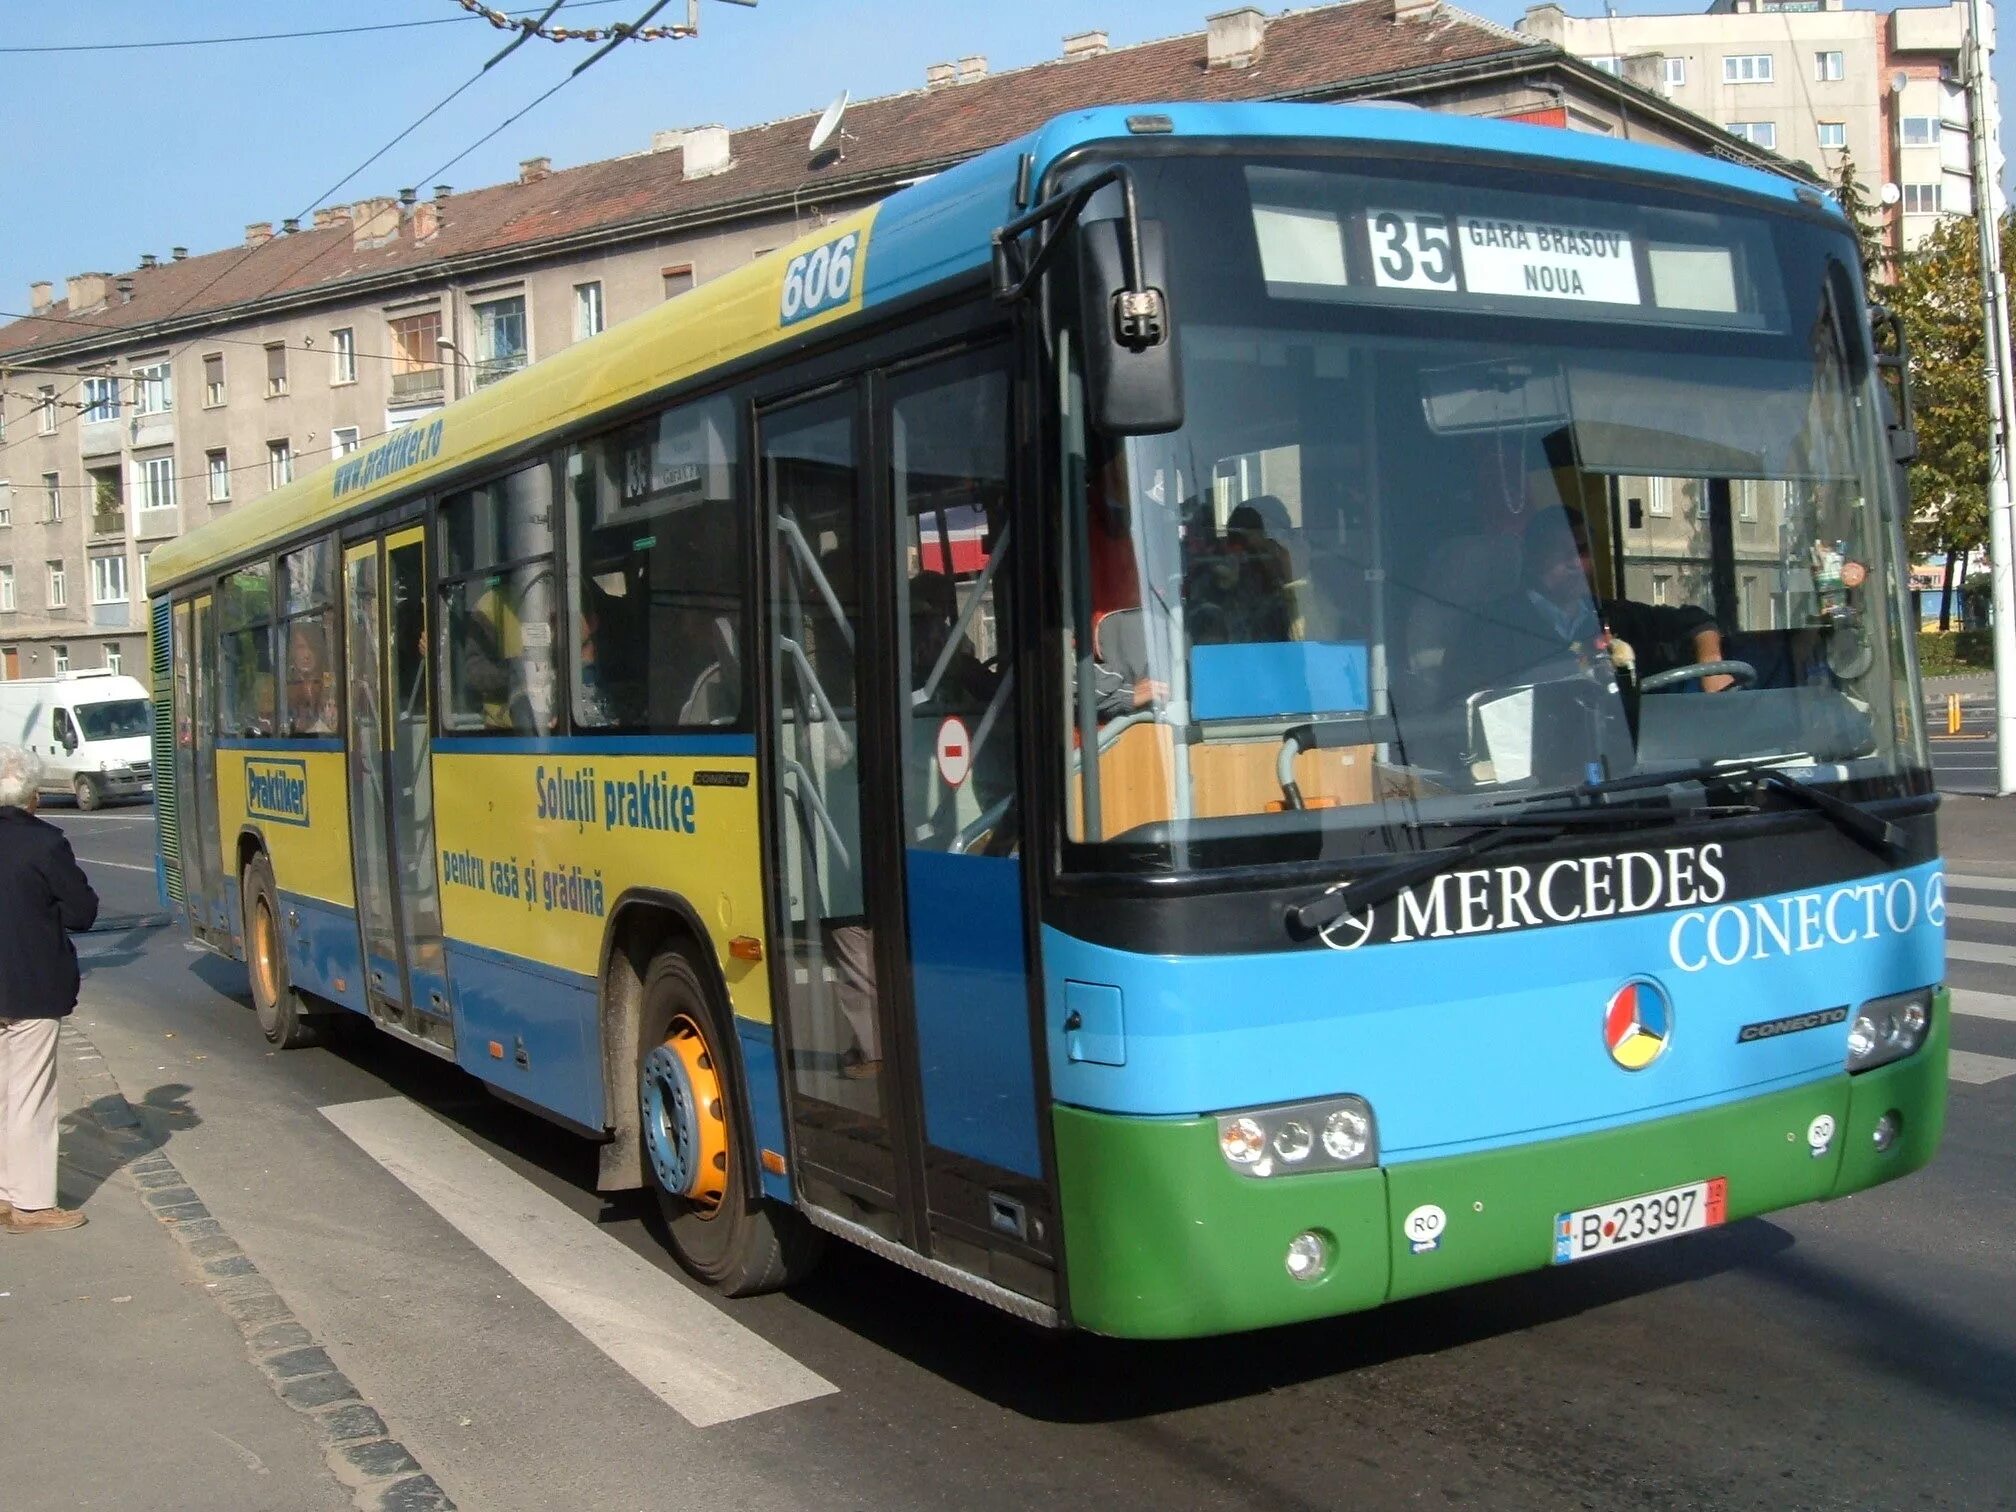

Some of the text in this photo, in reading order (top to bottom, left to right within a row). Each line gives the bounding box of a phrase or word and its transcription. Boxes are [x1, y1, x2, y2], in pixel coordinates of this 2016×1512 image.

[1375, 212, 1453, 284] 35
[1467, 219, 1622, 259] GARA BRASOV
[781, 233, 856, 318] 606
[1523, 263, 1585, 295] NOUA
[332, 417, 444, 499] www.praktiker.ro
[247, 767, 305, 816] Praktiker
[604, 769, 696, 834] praktice
[443, 849, 486, 890] pentru
[490, 856, 519, 899] casă
[543, 864, 605, 918] grădină
[1391, 842, 1726, 943] MERCEDES
[1669, 878, 1918, 972] CONECTO
[1741, 1008, 1846, 1041] CONECTO
[1414, 1214, 1439, 1233] RO
[1581, 1213, 1602, 1252] B
[1612, 1190, 1698, 1244] 23397
